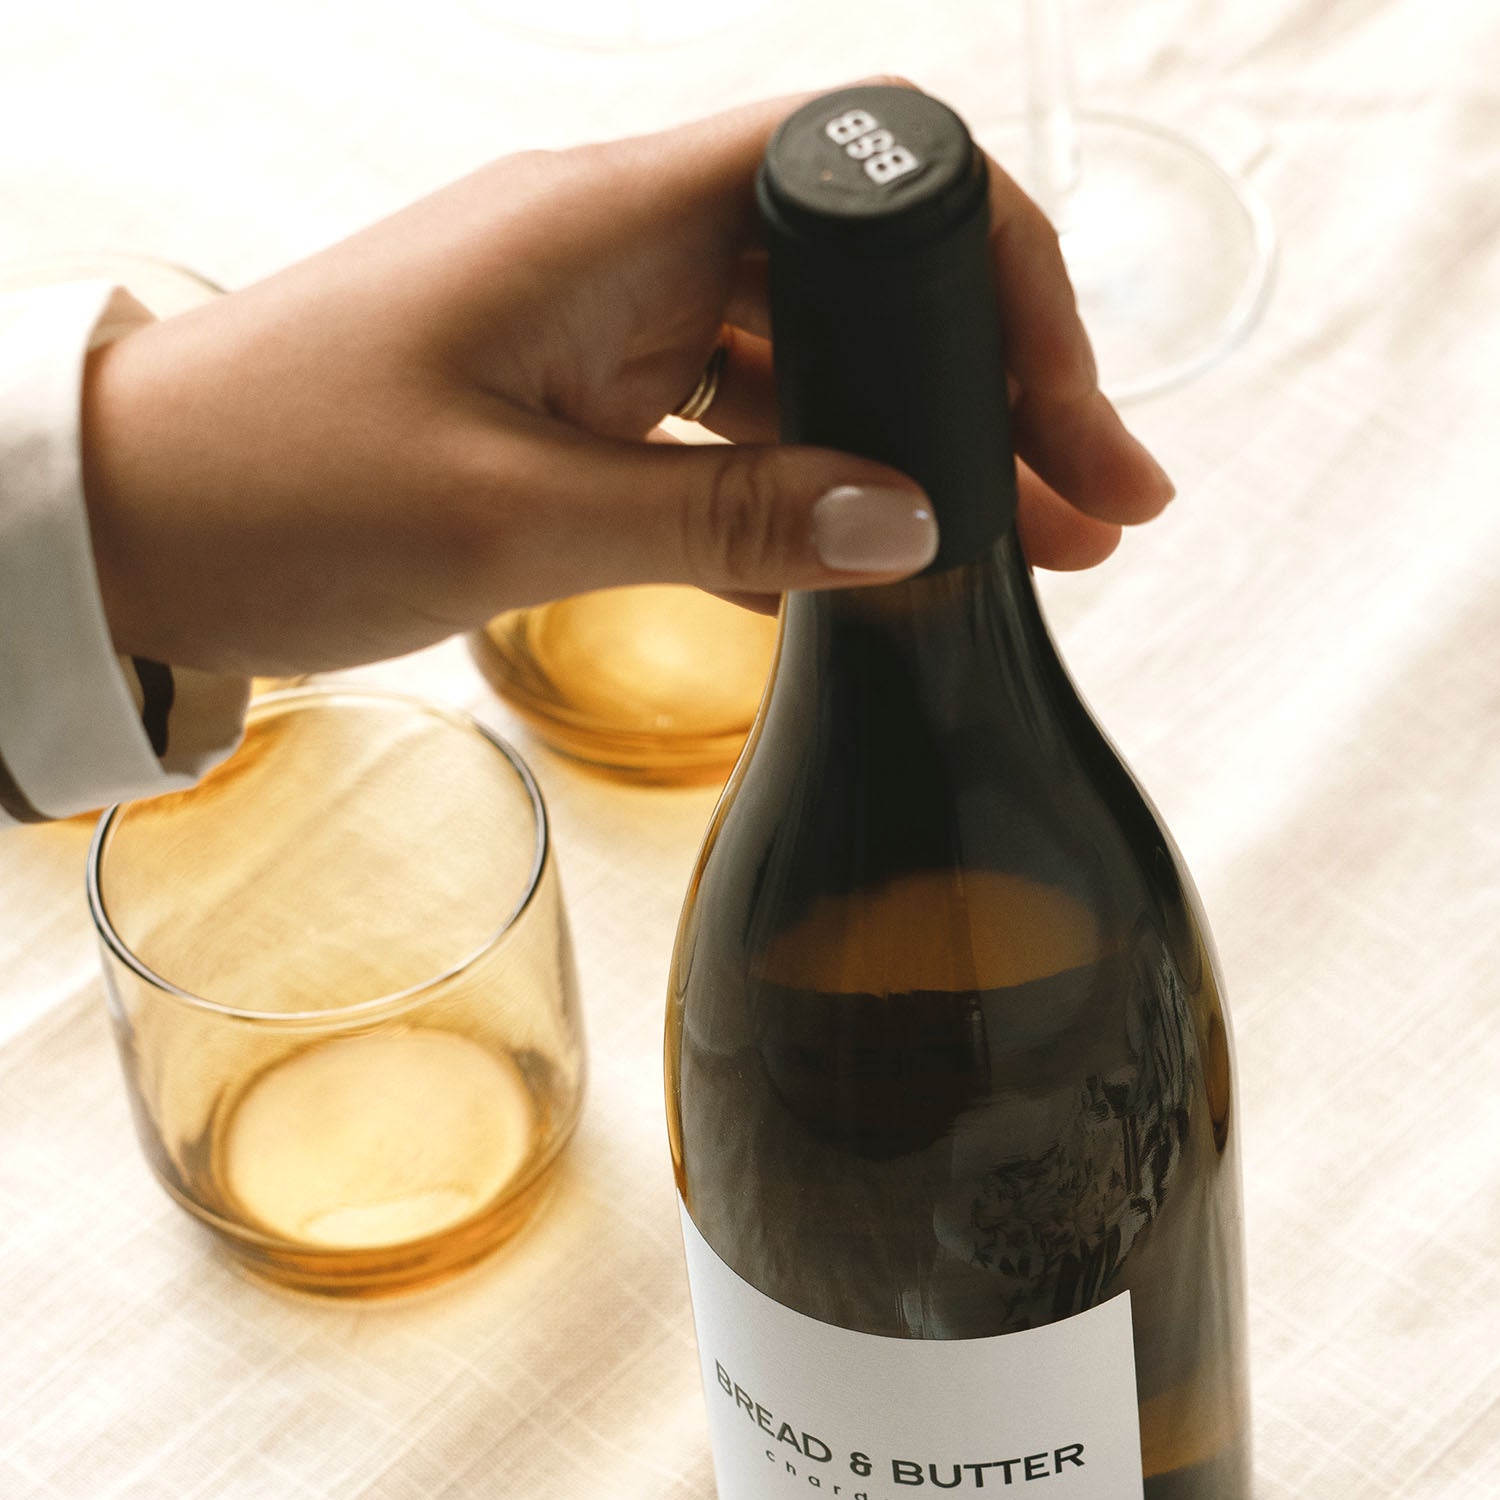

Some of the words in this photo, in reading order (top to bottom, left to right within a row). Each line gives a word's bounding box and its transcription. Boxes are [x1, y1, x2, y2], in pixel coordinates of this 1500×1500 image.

[715, 1359, 833, 1463] BREAD
[849, 1451, 873, 1478] &
[892, 1443, 1086, 1489] BUTTER
